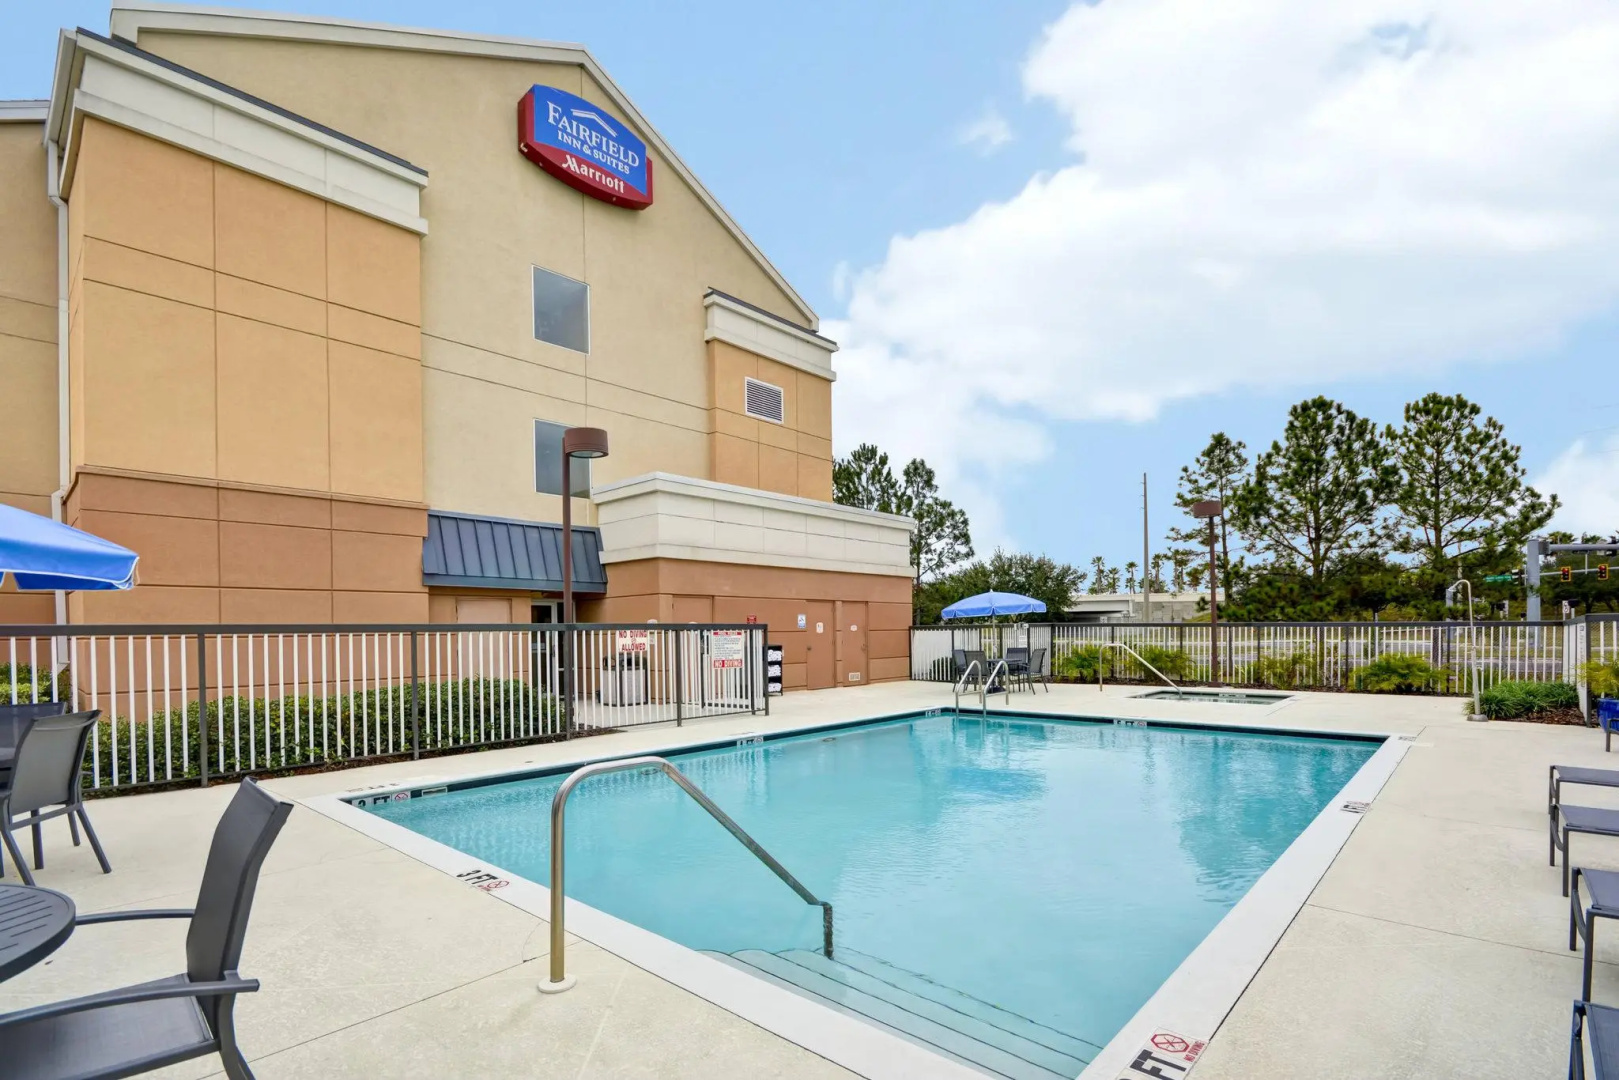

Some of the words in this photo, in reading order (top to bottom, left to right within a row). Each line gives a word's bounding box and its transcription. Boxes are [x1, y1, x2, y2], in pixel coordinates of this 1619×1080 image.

[546, 100, 640, 167] FAIRFIELD
[557, 130, 582, 149] INN
[582, 144, 592, 155] &
[593, 149, 630, 175] SUITES
[561, 154, 625, 194] Marriott
[619, 628, 627, 638] NO
[630, 628, 647, 638] DIVING
[622, 643, 646, 651] ALLOWED
[714, 659, 722, 668] NO
[724, 659, 742, 667] DIVING
[1129, 1049, 1187, 1080] FT
